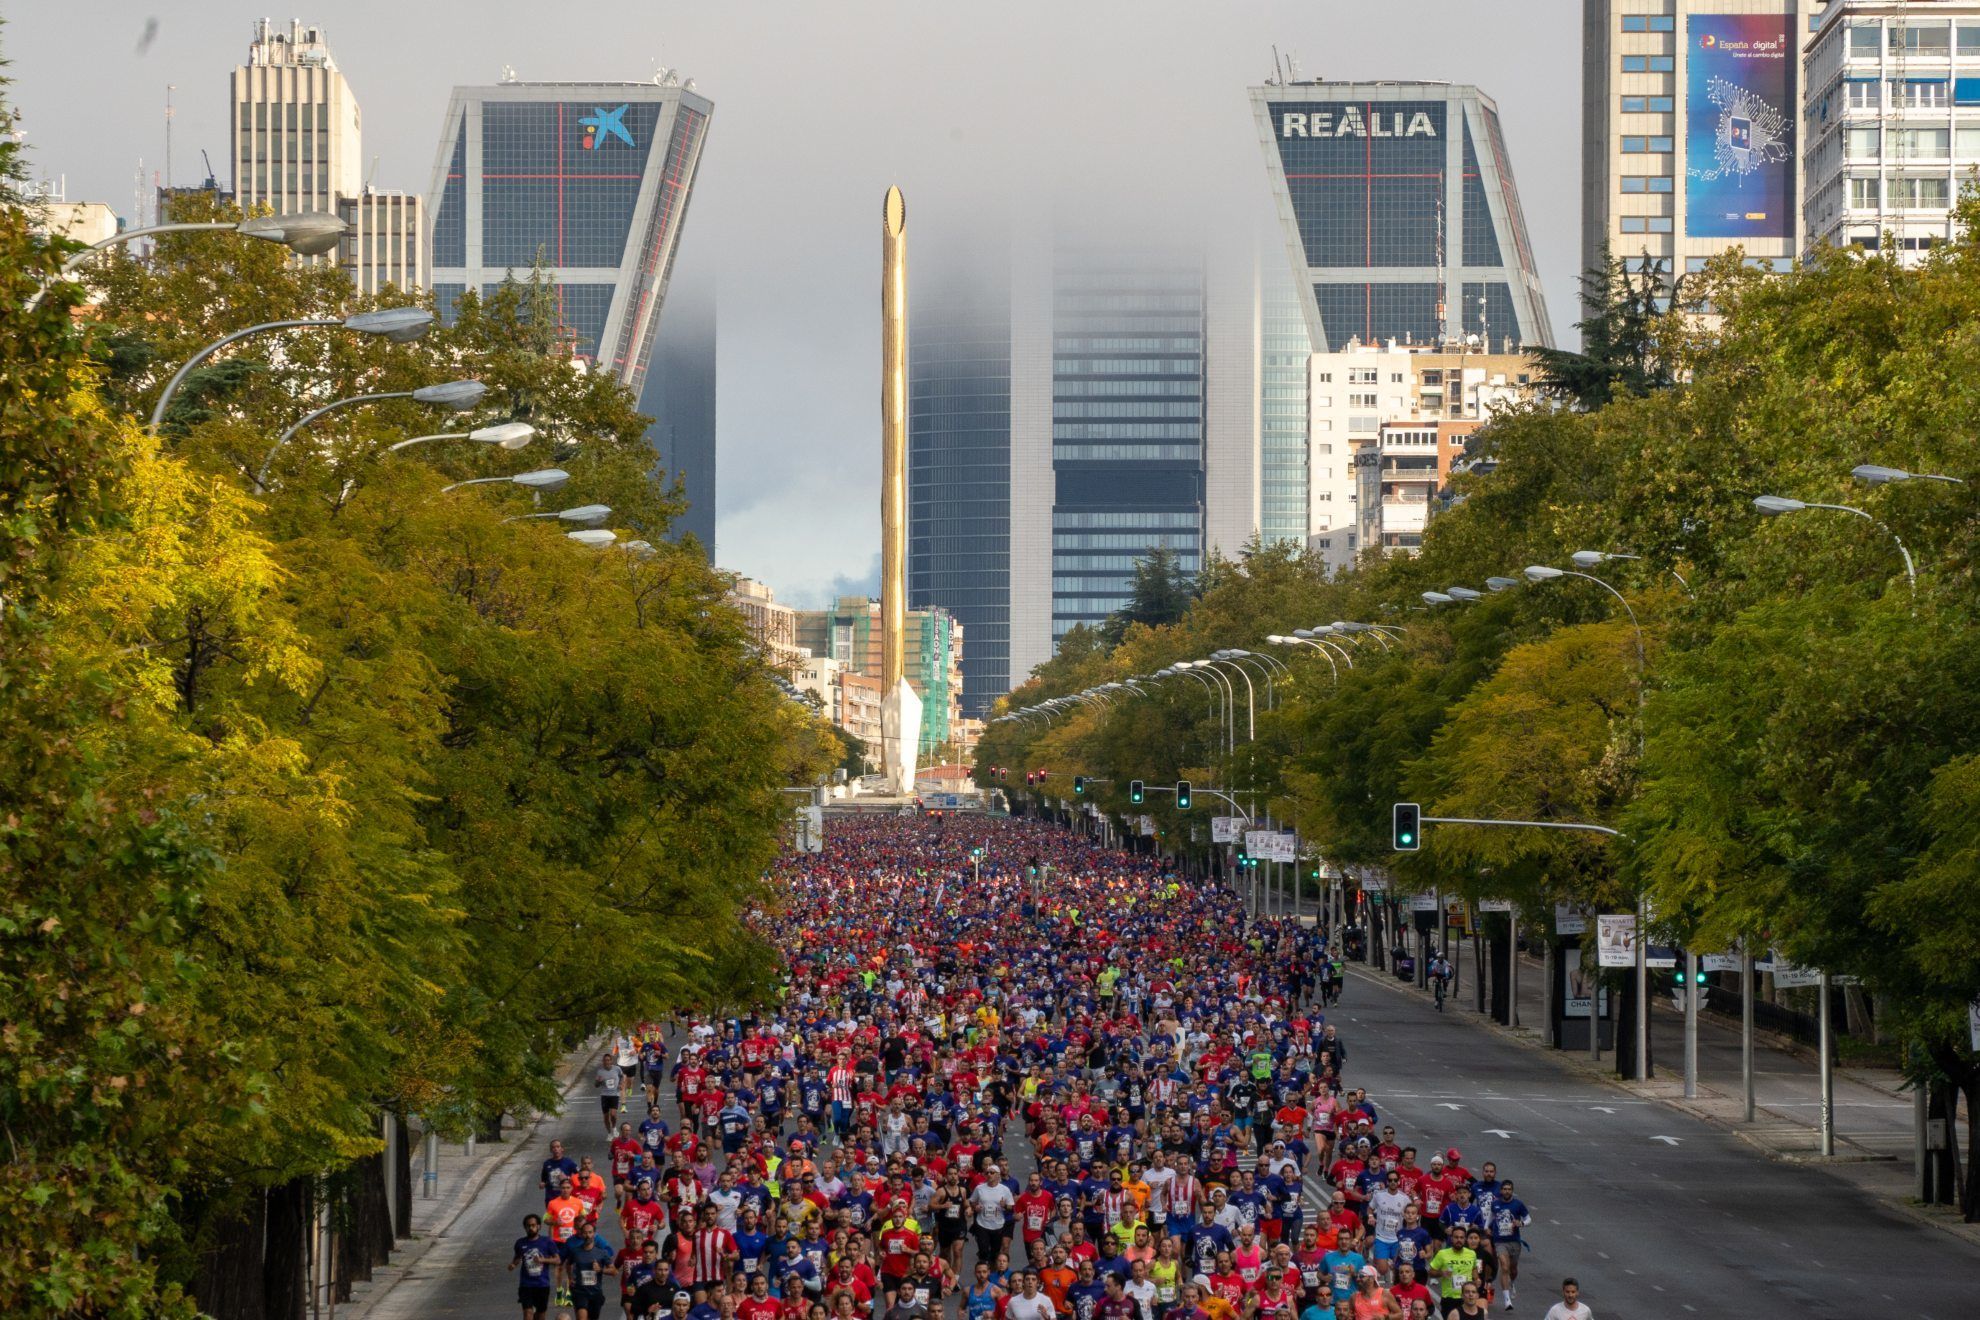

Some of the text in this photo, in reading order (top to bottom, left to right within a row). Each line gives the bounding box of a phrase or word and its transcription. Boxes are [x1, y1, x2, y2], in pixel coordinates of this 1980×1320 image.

[1719, 41, 1777, 50] España digital
[1283, 106, 1436, 137] REALIA
